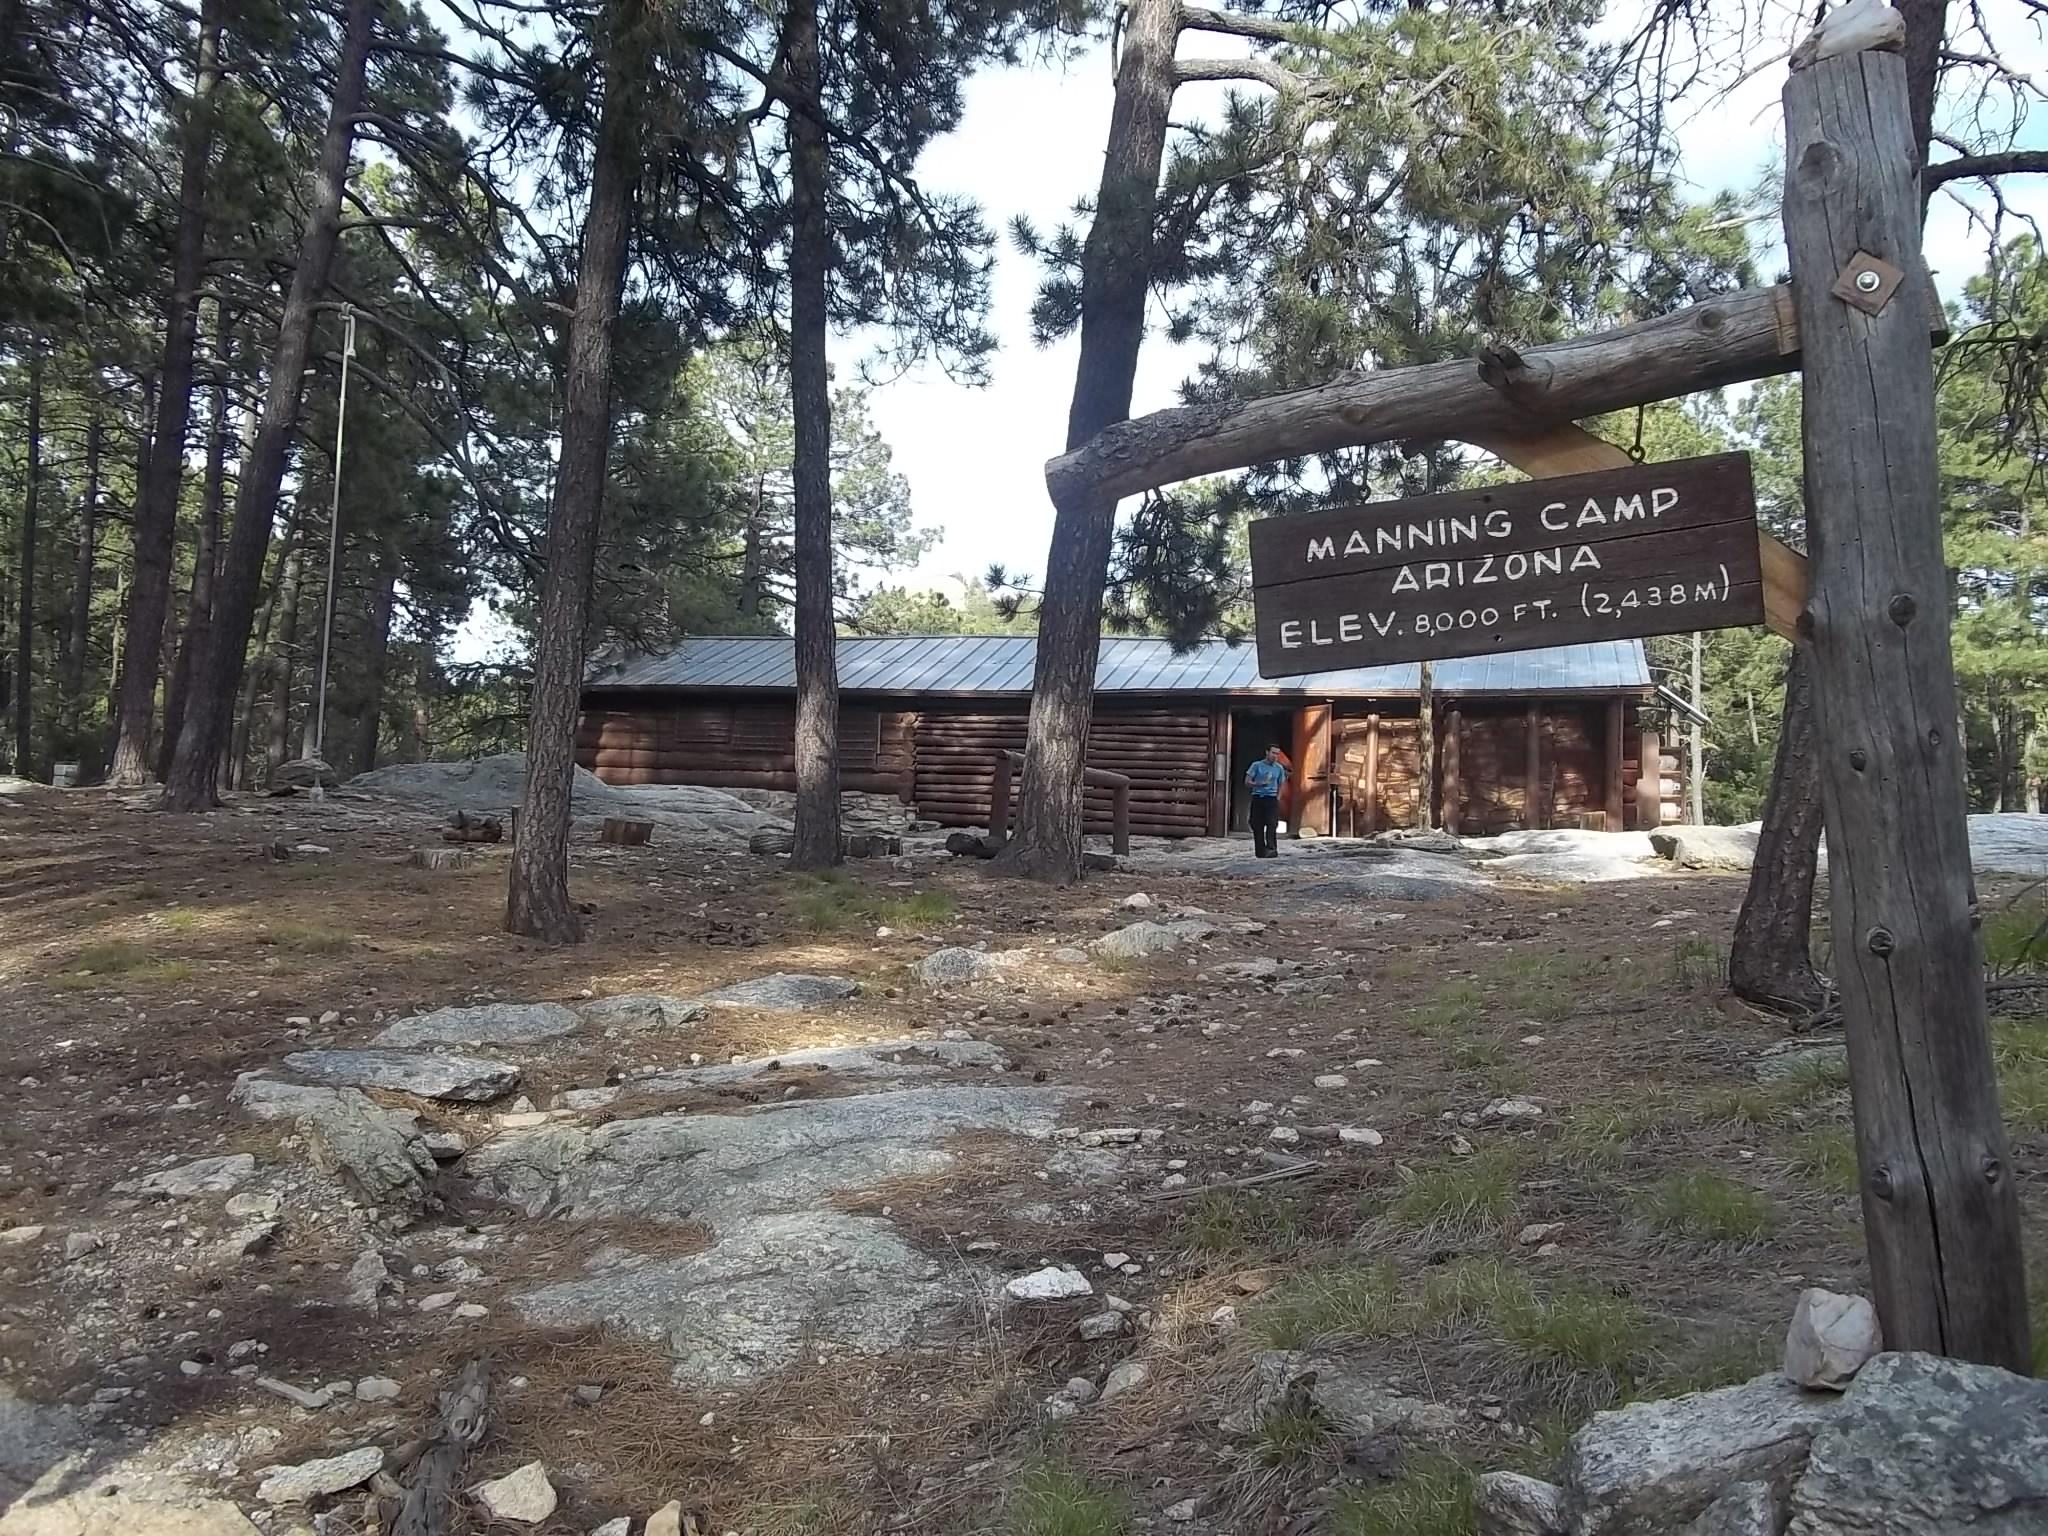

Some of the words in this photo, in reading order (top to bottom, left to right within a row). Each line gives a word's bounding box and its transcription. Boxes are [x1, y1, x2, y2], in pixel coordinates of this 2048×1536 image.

[1307, 510, 1512, 562] MANNING
[1541, 488, 1679, 531] CAMP
[1391, 545, 1601, 594] ARIZONA
[1280, 611, 1404, 649] ELEV.
[1414, 607, 1499, 637] 8,000
[1513, 599, 1558, 622] FT.
